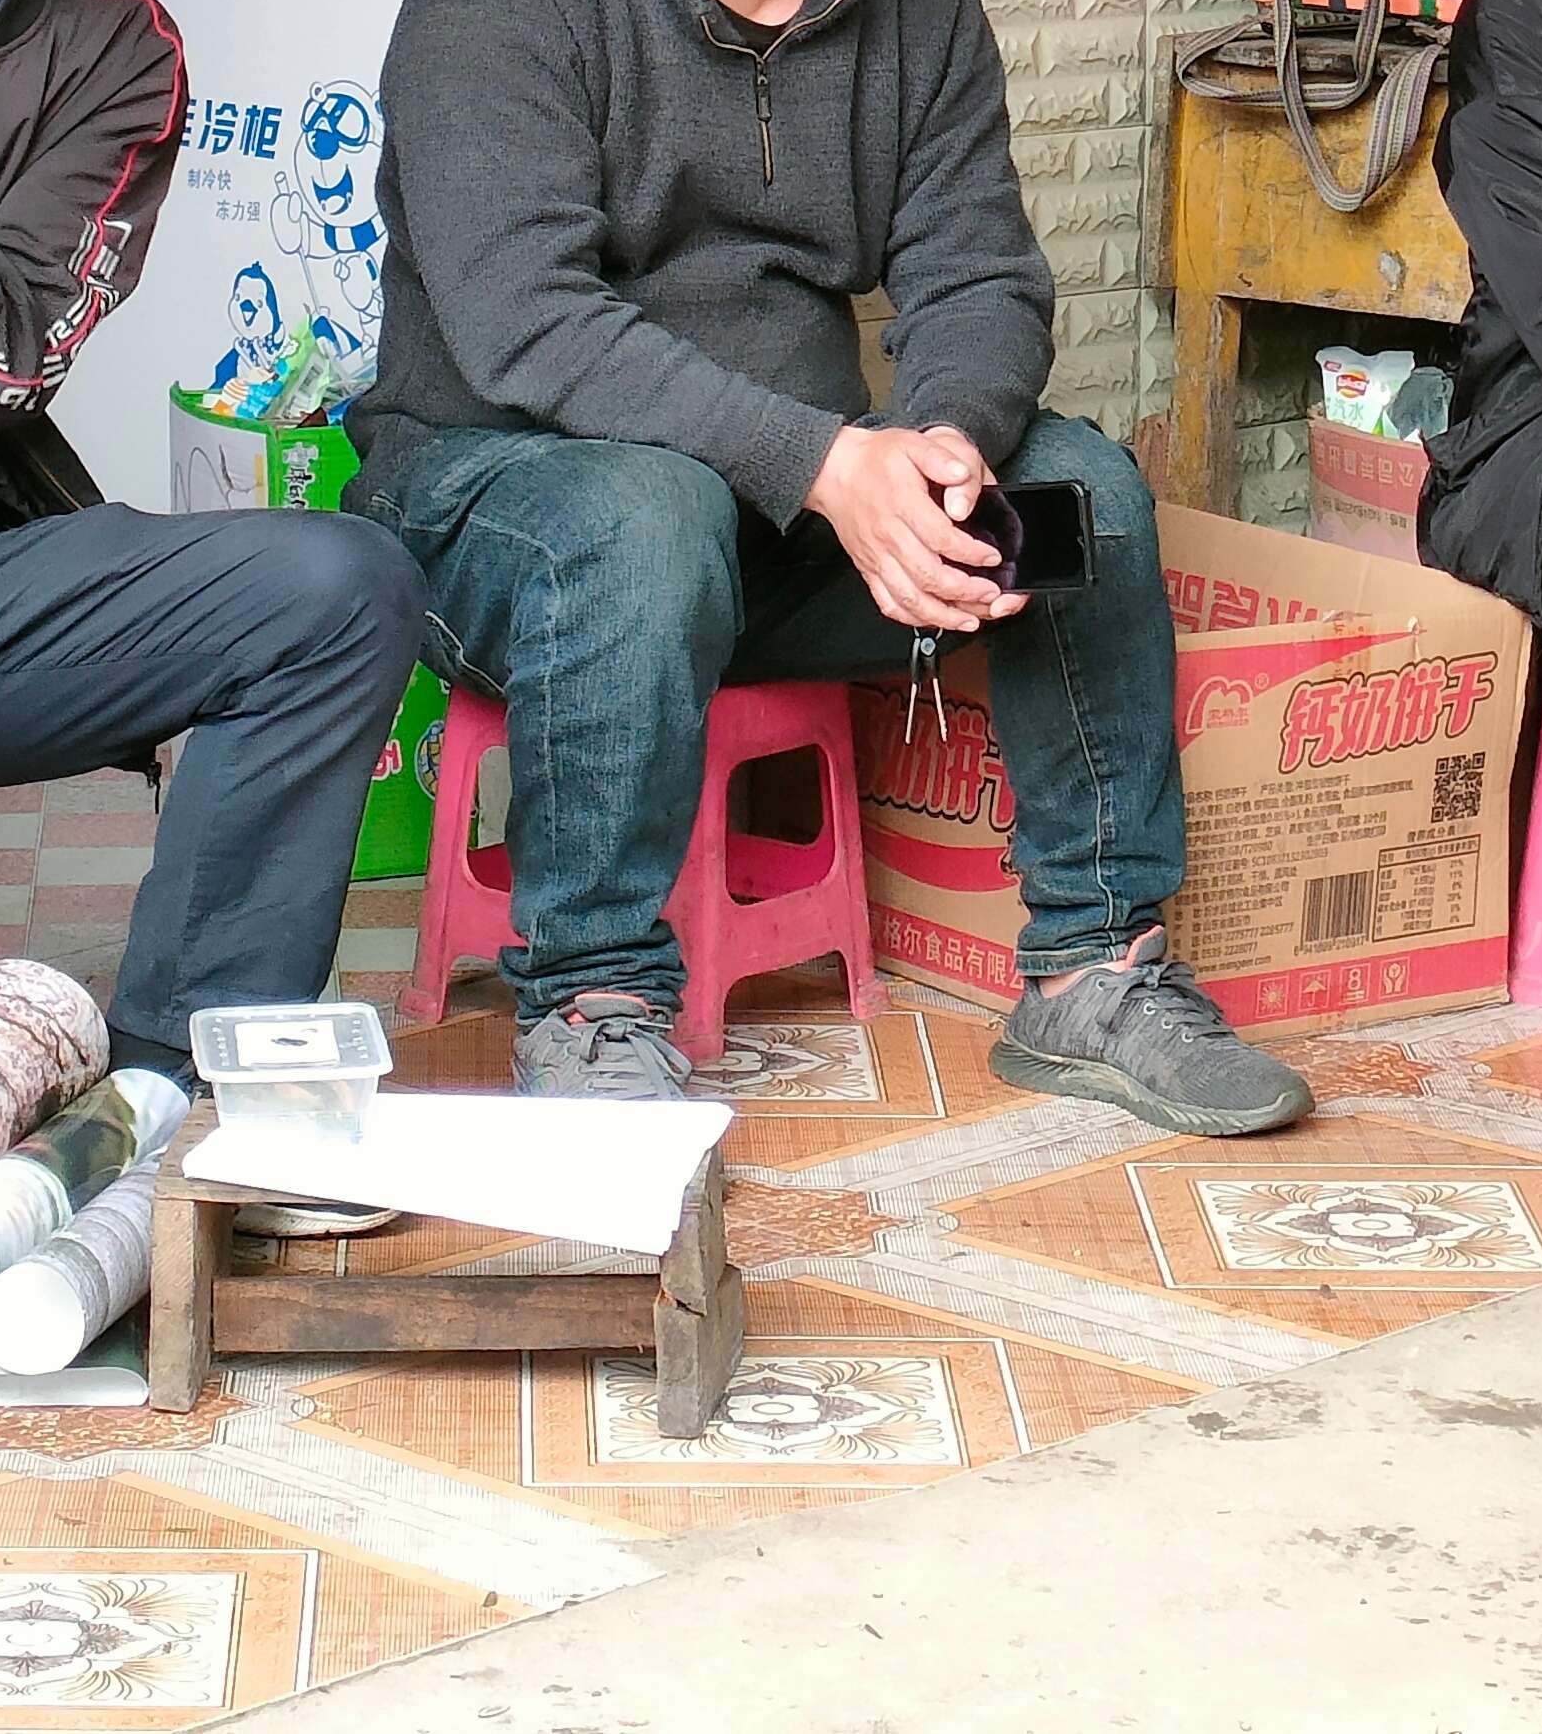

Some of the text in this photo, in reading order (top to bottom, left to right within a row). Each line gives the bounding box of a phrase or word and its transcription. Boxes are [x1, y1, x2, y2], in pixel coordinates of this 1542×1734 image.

[187, 168, 231, 191] 制冷快
[216, 200, 261, 222] 冻力强
[1280, 654, 1497, 773] 钙奶饼干
